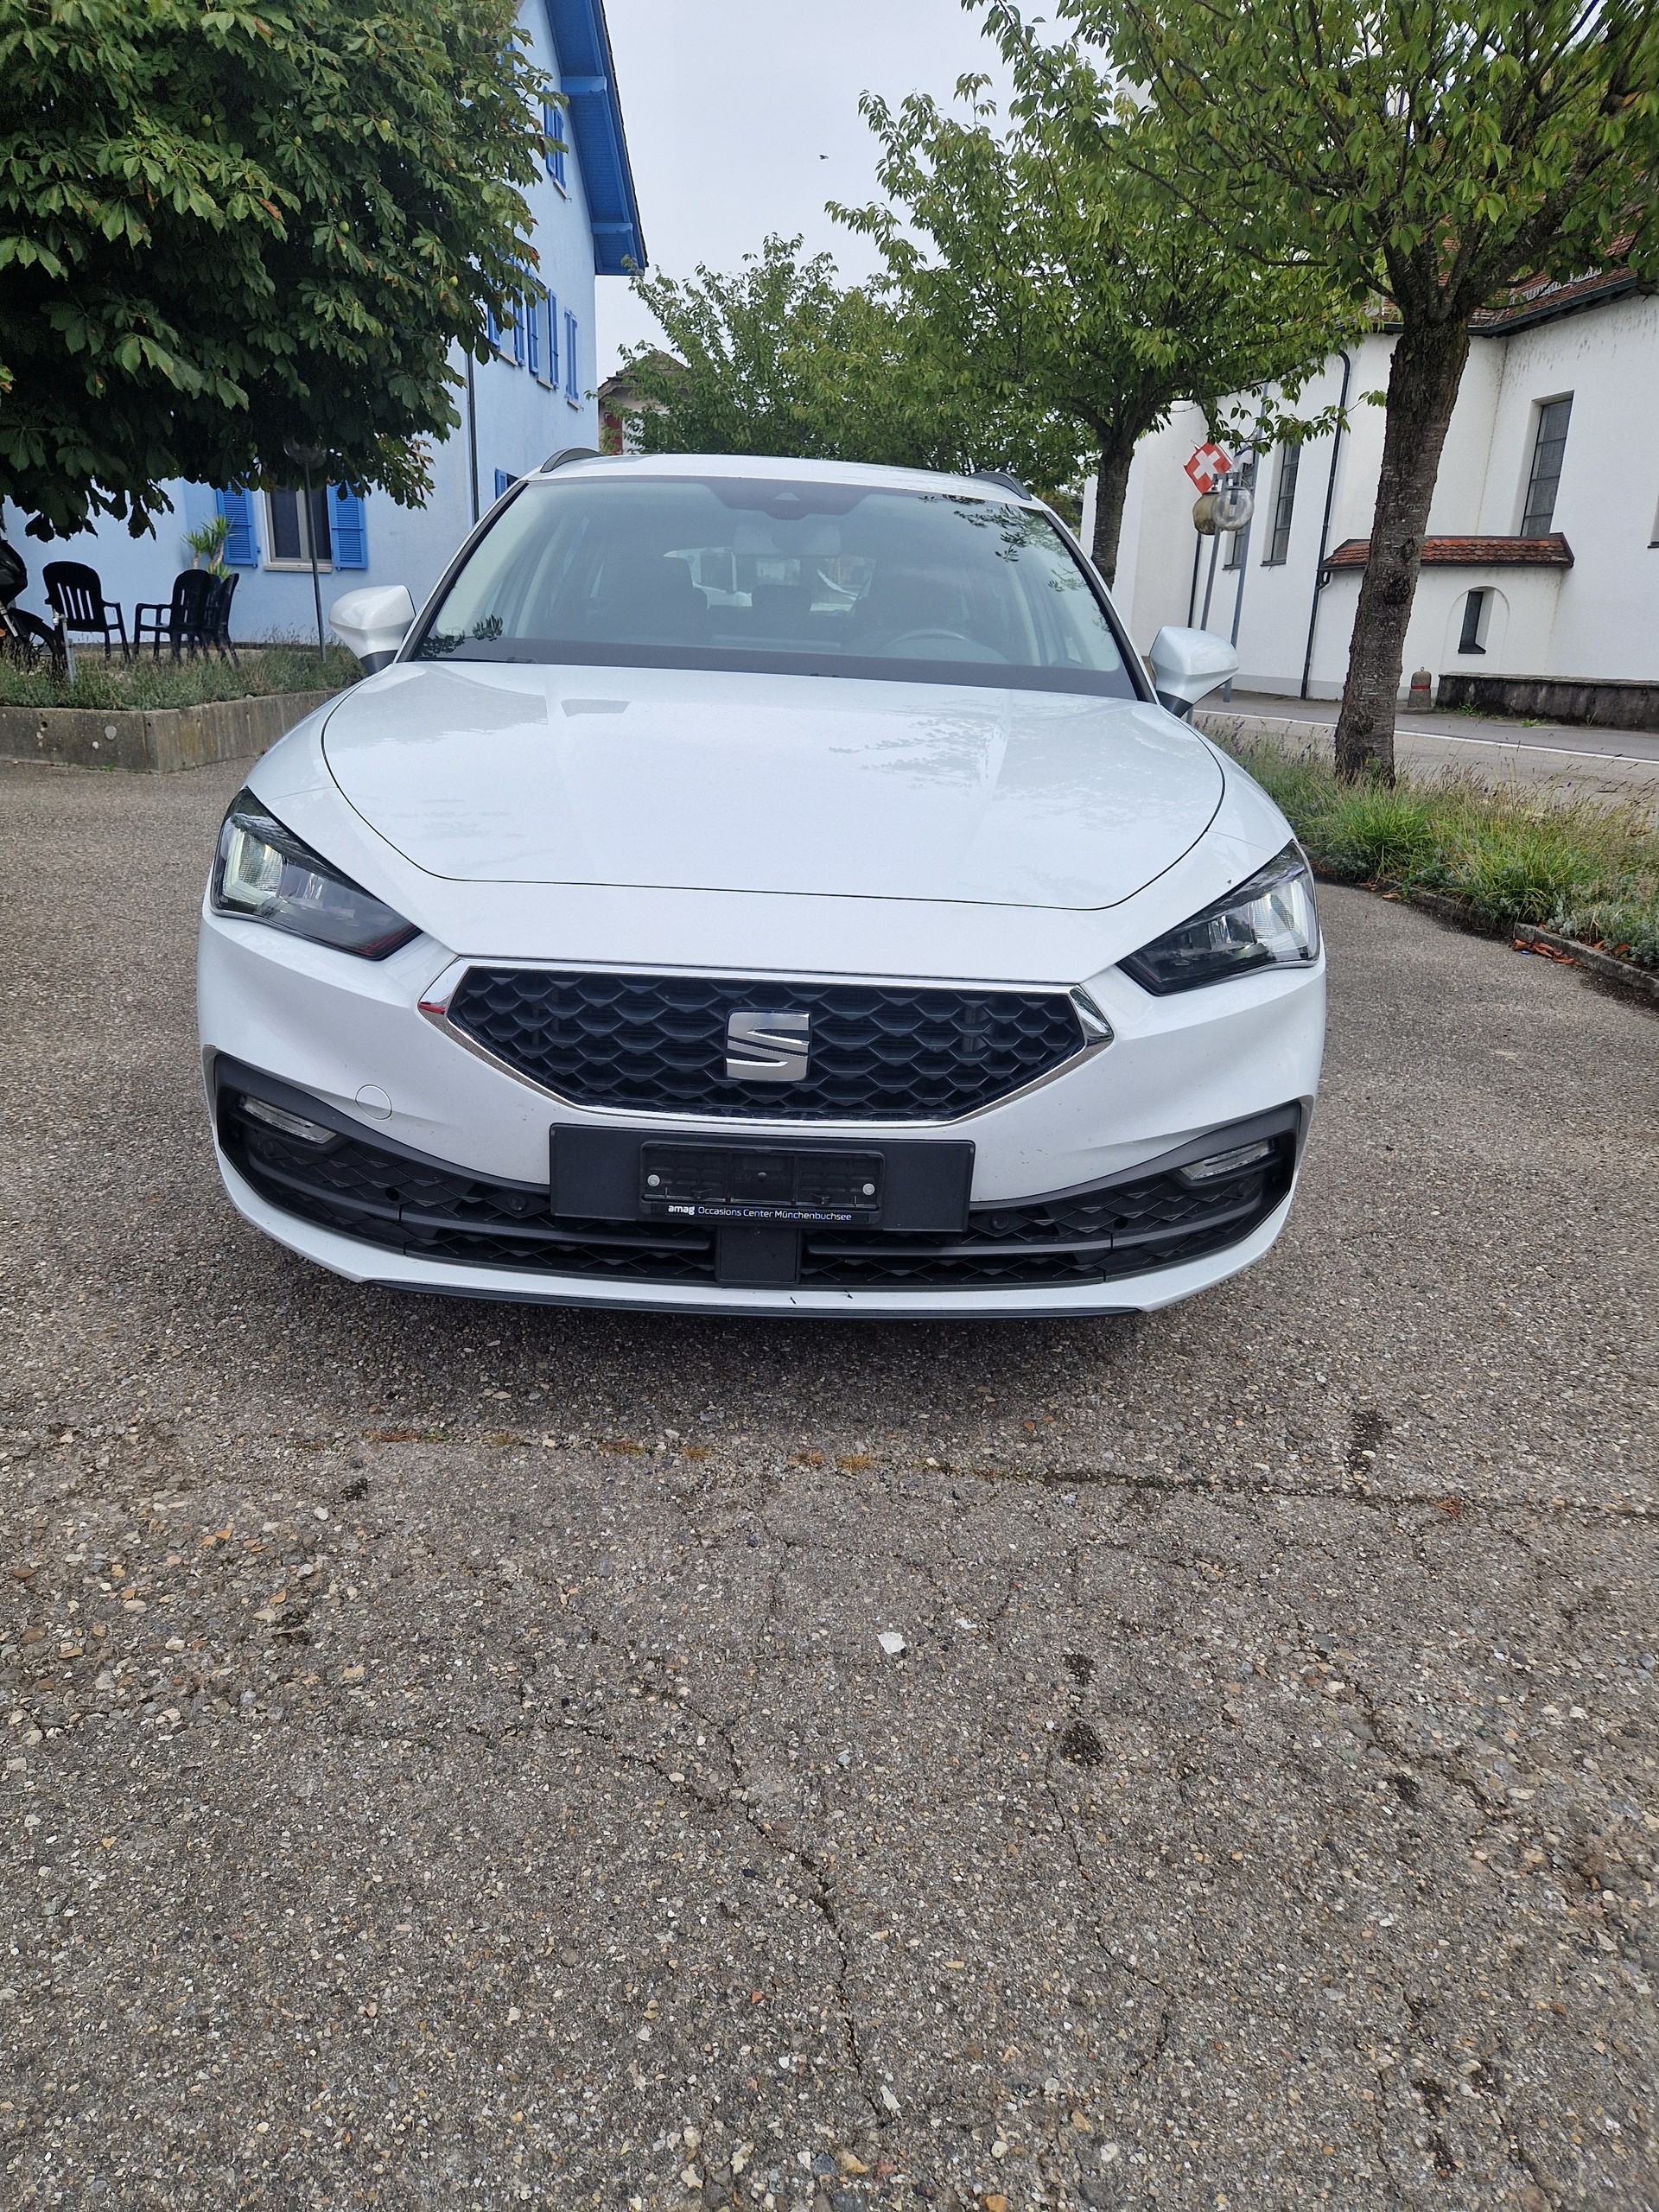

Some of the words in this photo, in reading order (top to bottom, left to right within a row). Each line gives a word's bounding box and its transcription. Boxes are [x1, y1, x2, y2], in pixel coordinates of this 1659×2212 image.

[668, 1205, 695, 1216] amag
[697, 1206, 742, 1217] Occasions
[743, 1208, 774, 1218] Center
[774, 1209, 852, 1221] Münchenbuchsee
